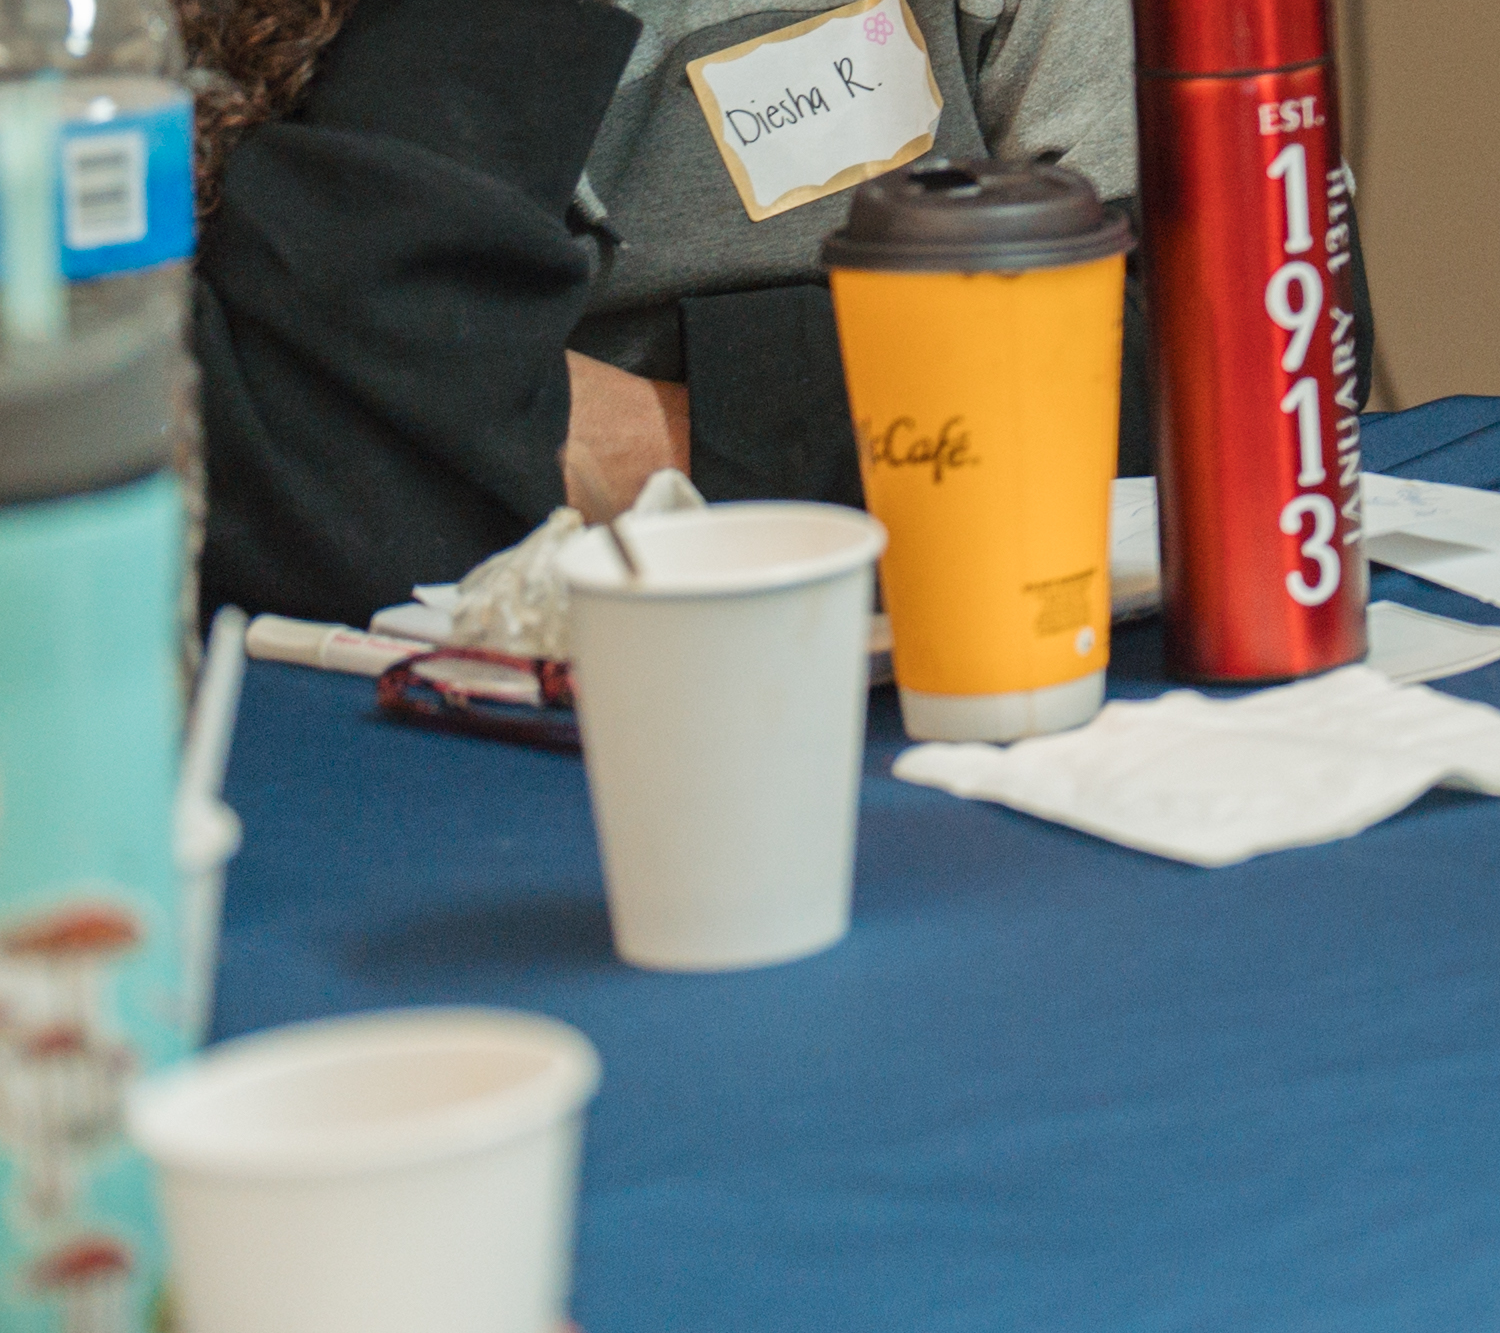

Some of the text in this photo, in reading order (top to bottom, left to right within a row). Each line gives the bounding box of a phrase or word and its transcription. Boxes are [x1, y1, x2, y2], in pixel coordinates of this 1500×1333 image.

[726, 57, 883, 147] Diesha R.
[1258, 96, 1325, 135] EST.
[1325, 168, 1349, 275] 13TH
[1264, 142, 1342, 607] 1913
